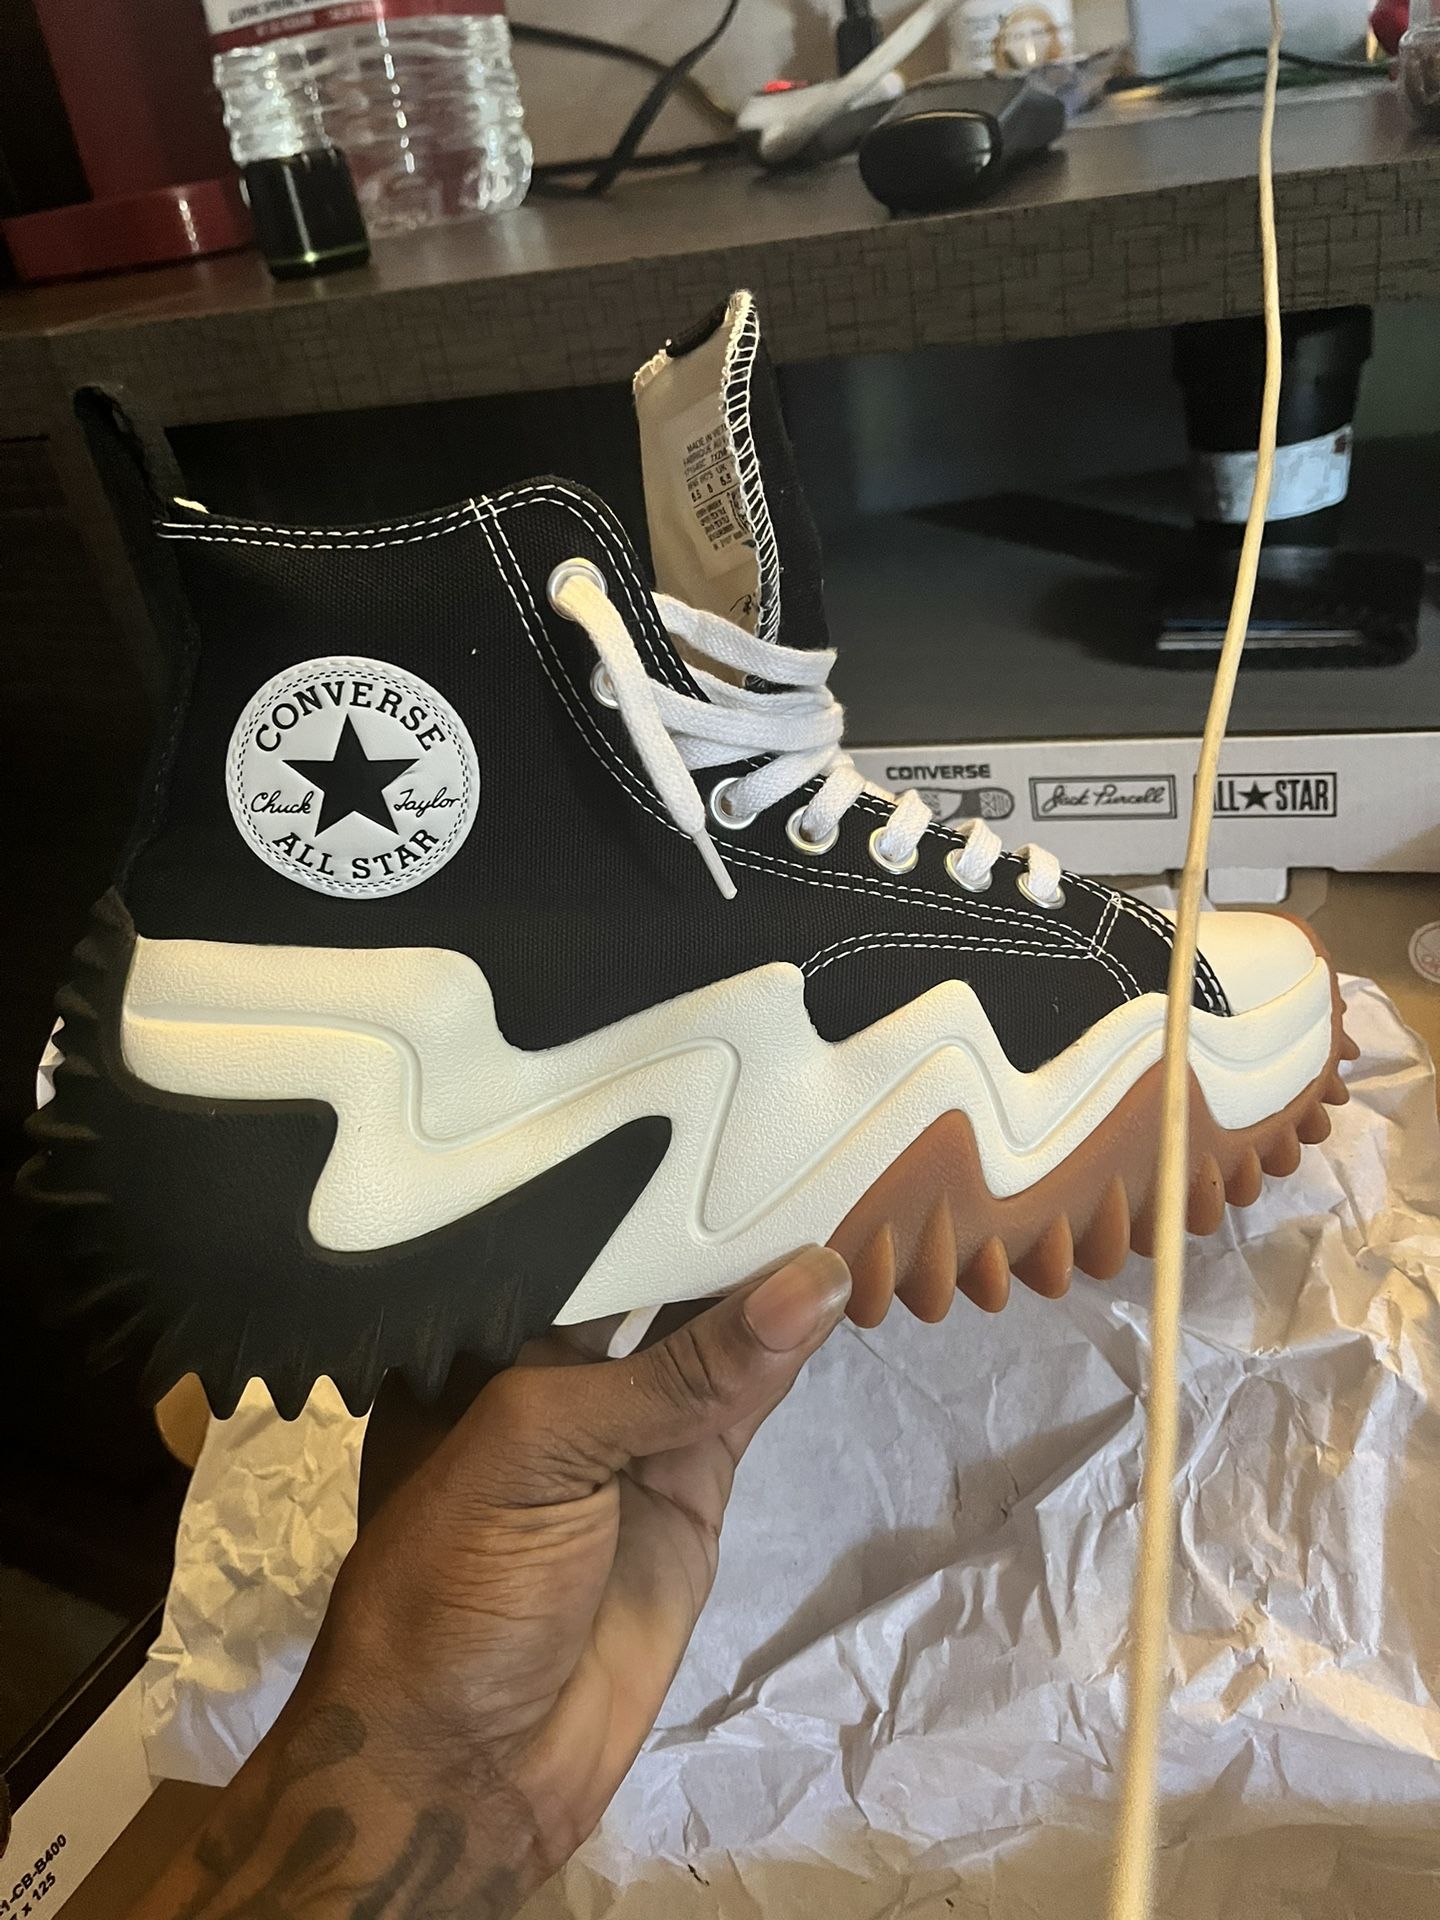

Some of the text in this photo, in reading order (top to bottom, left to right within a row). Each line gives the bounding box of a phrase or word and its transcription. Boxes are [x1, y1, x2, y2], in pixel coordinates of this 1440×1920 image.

[716, 464, 727, 473] UK
[255, 681, 446, 752] CONVERSE
[886, 764, 991, 780] CONVERSE
[250, 786, 461, 817] Chuck Taylor
[1041, 783, 1165, 813] Jack Purcell
[1275, 779, 1328, 811] STAR
[272, 829, 439, 879] ALL STAR
[0, 1834, 66, 1916] 1-CB-B400
[33, 1872, 55, 1900] 125
